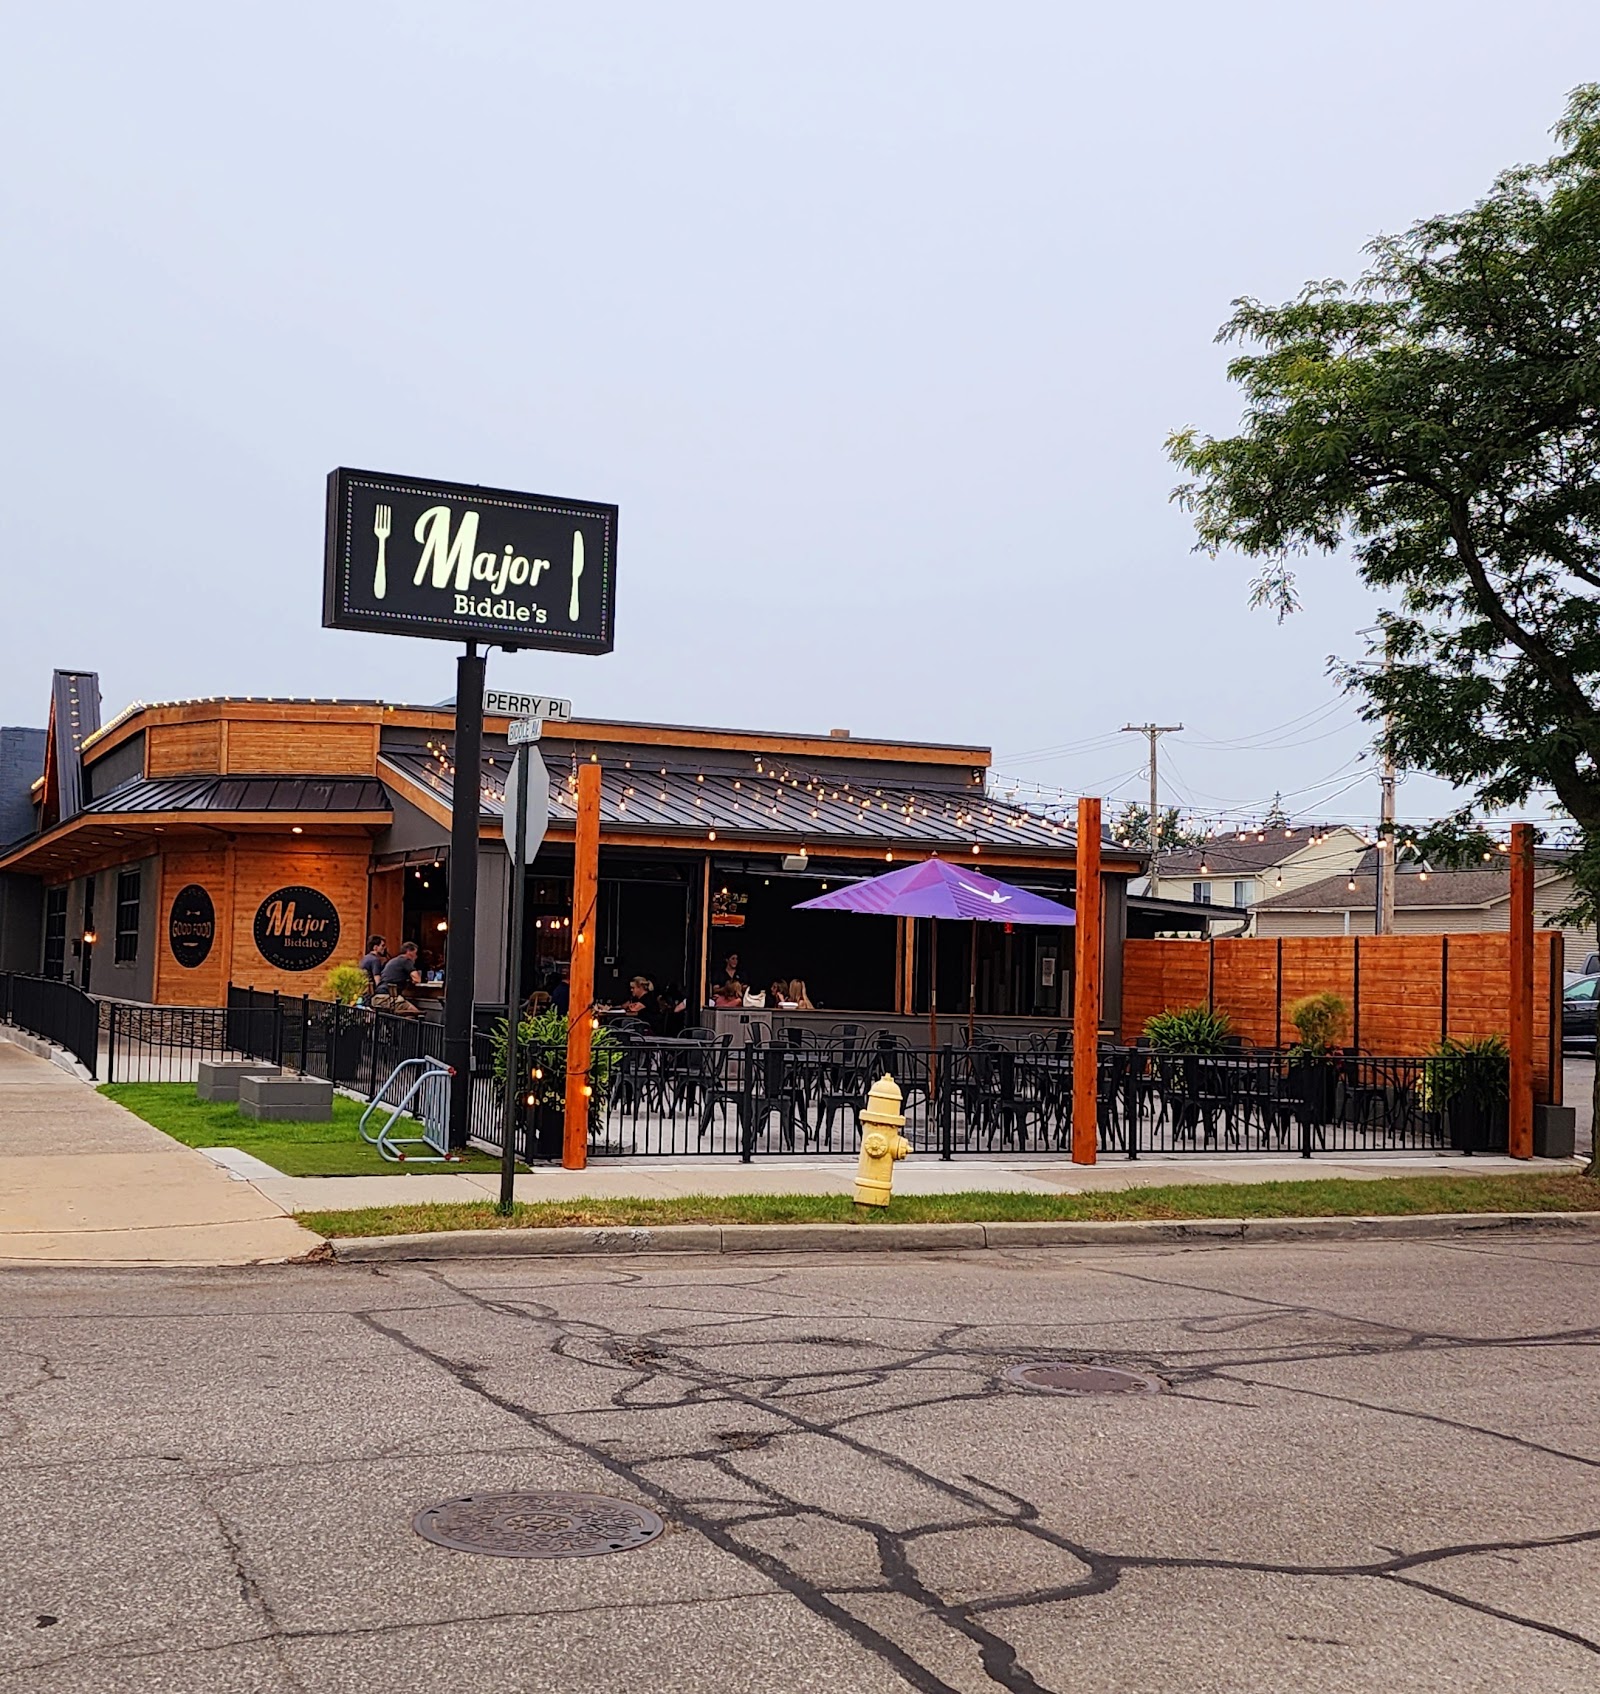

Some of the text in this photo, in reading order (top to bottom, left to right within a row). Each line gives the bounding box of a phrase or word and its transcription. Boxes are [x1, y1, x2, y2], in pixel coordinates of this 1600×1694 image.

[413, 505, 550, 595] Major
[453, 594, 548, 624] Biddle's
[487, 693, 567, 718] PERRY PL
[509, 722, 529, 740] BIDDLE
[172, 920, 212, 938] GOOD FOOD
[265, 900, 329, 937] Major
[284, 937, 328, 948] Biddle's
